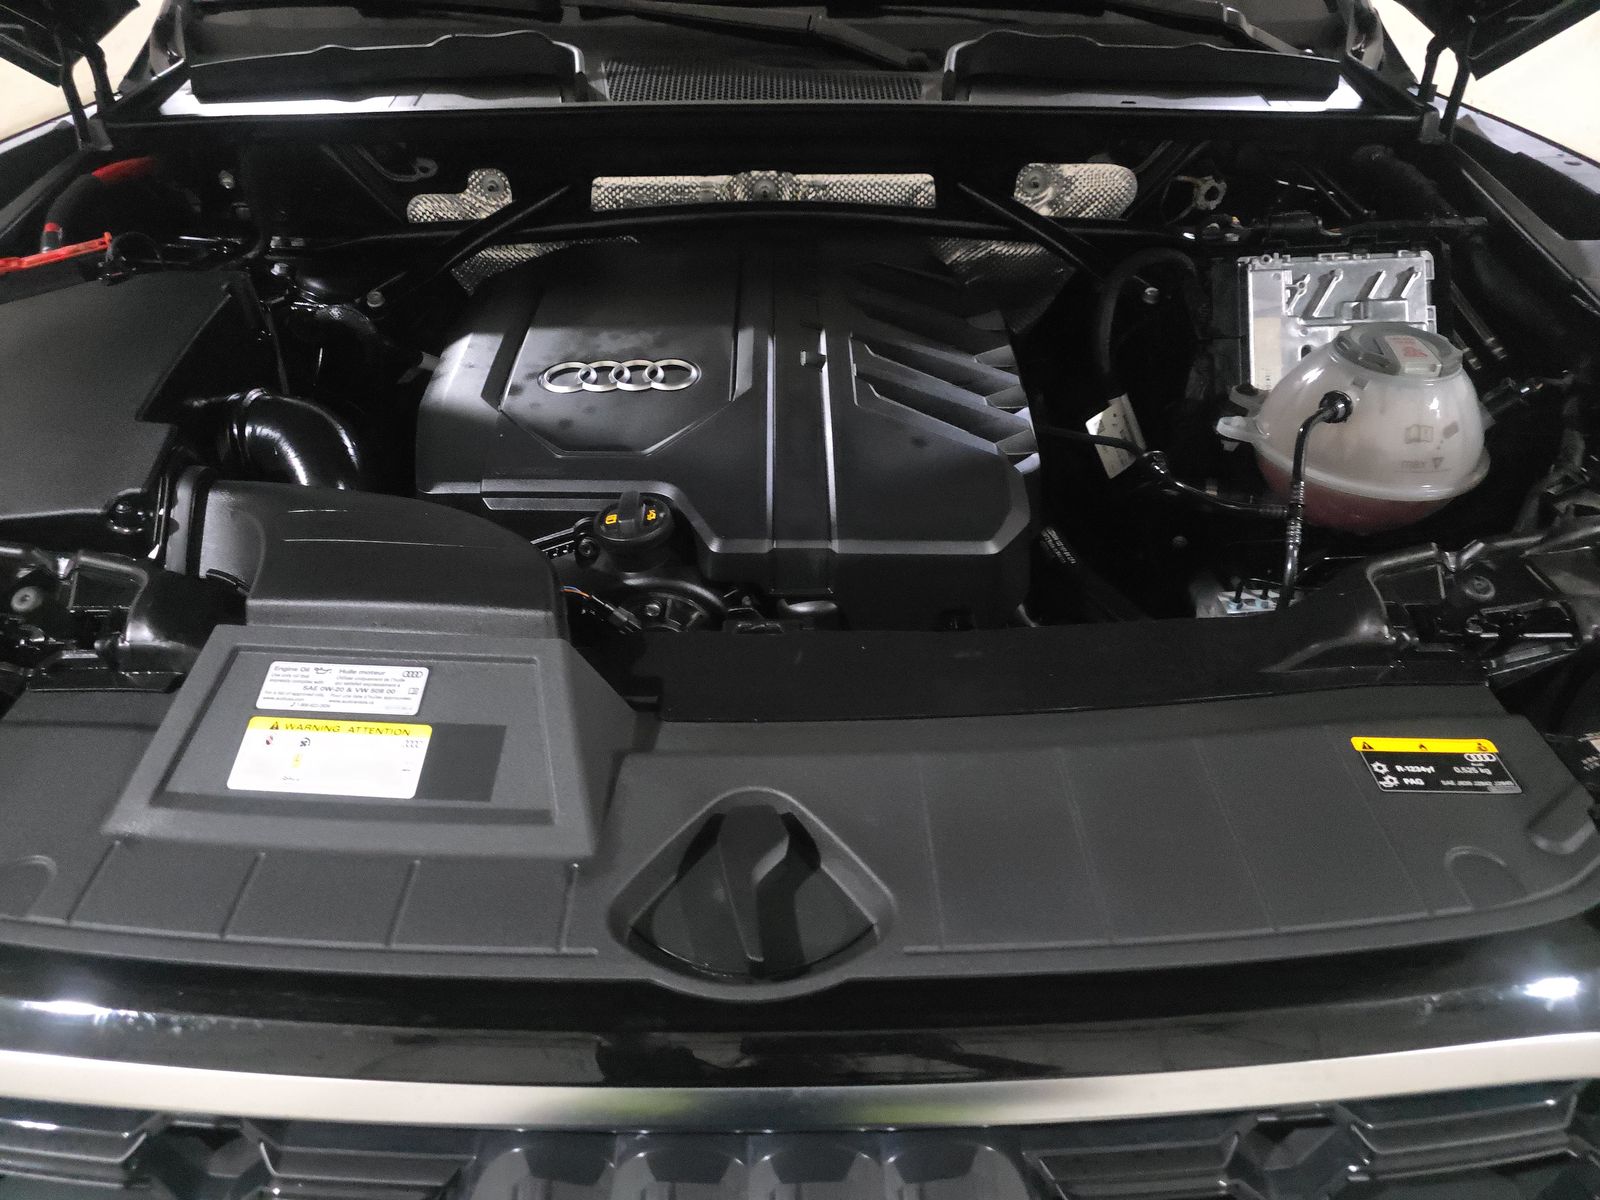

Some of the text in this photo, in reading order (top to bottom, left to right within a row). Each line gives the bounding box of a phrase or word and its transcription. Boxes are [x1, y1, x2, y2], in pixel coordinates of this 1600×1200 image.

[285, 723, 412, 736] WARNING ATTENTION
[1478, 766, 1493, 775] kg
